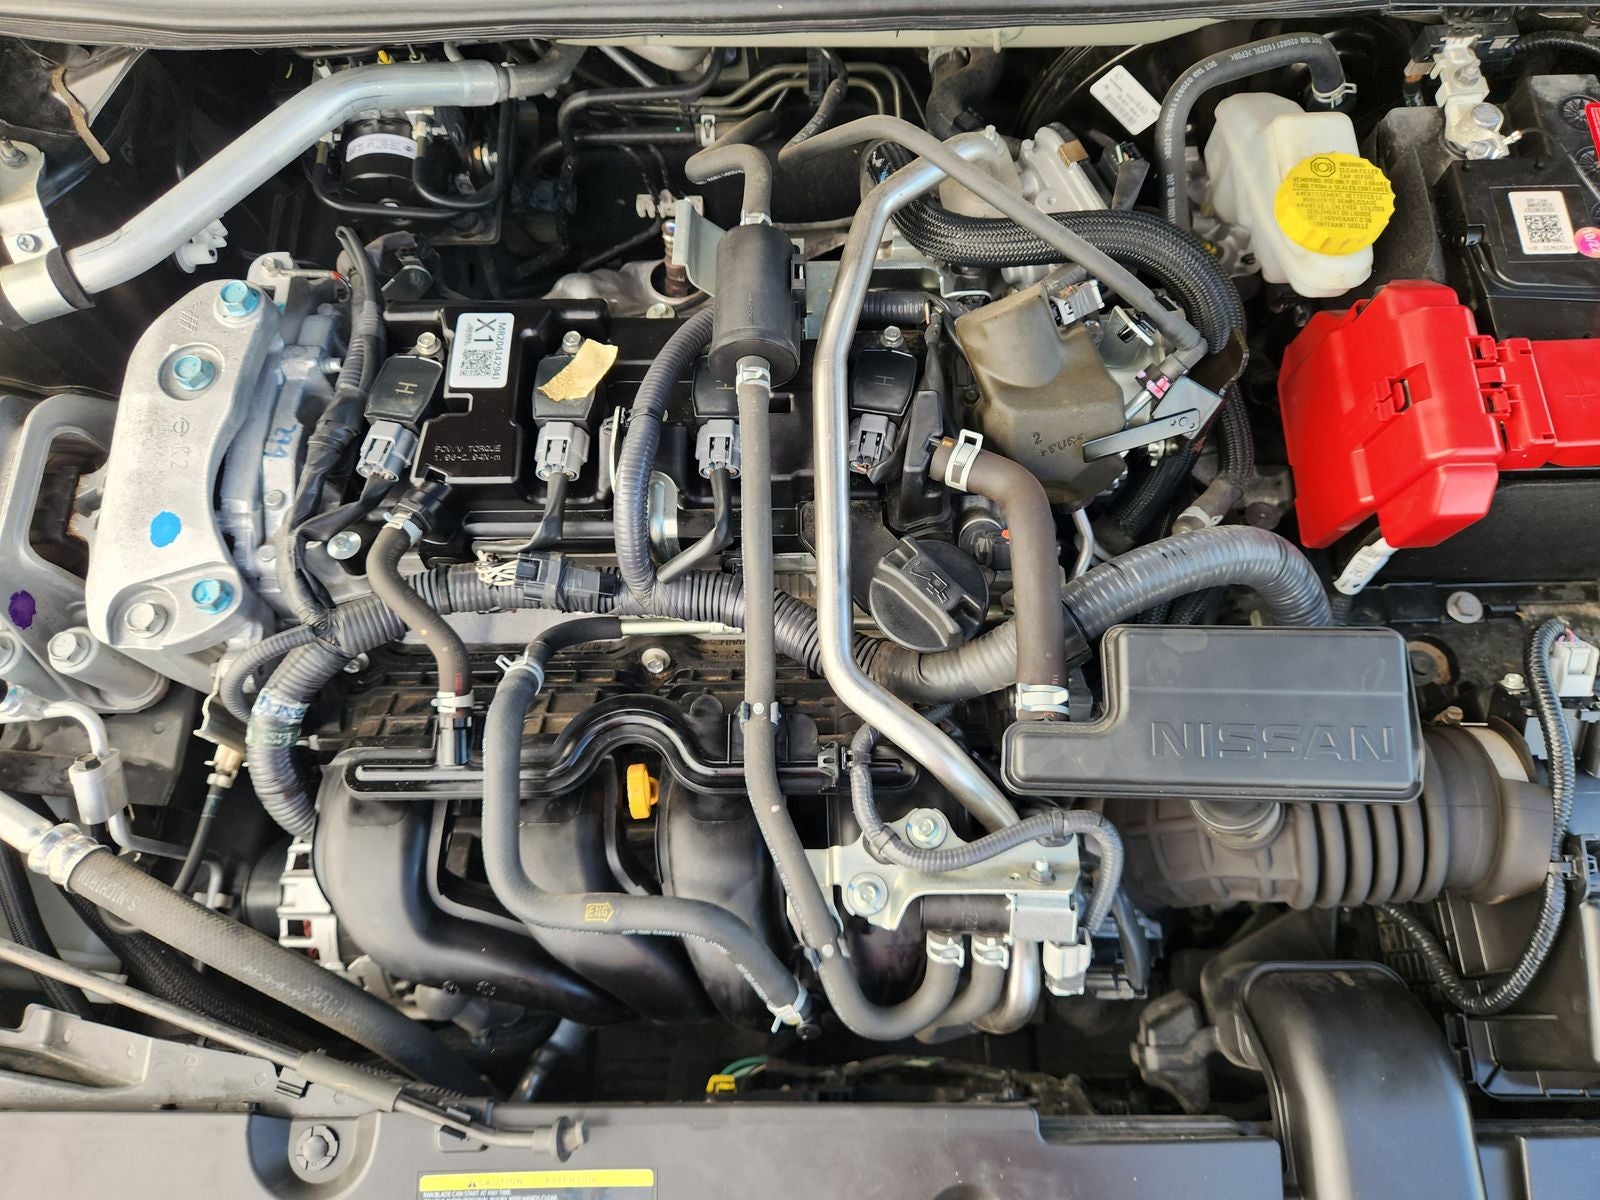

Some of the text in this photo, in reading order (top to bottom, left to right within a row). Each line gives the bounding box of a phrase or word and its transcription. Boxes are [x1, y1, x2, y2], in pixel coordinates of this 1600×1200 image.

[473, 317, 497, 342] X1
[395, 381, 418, 395] H
[1150, 721, 1397, 763] NISSAN
